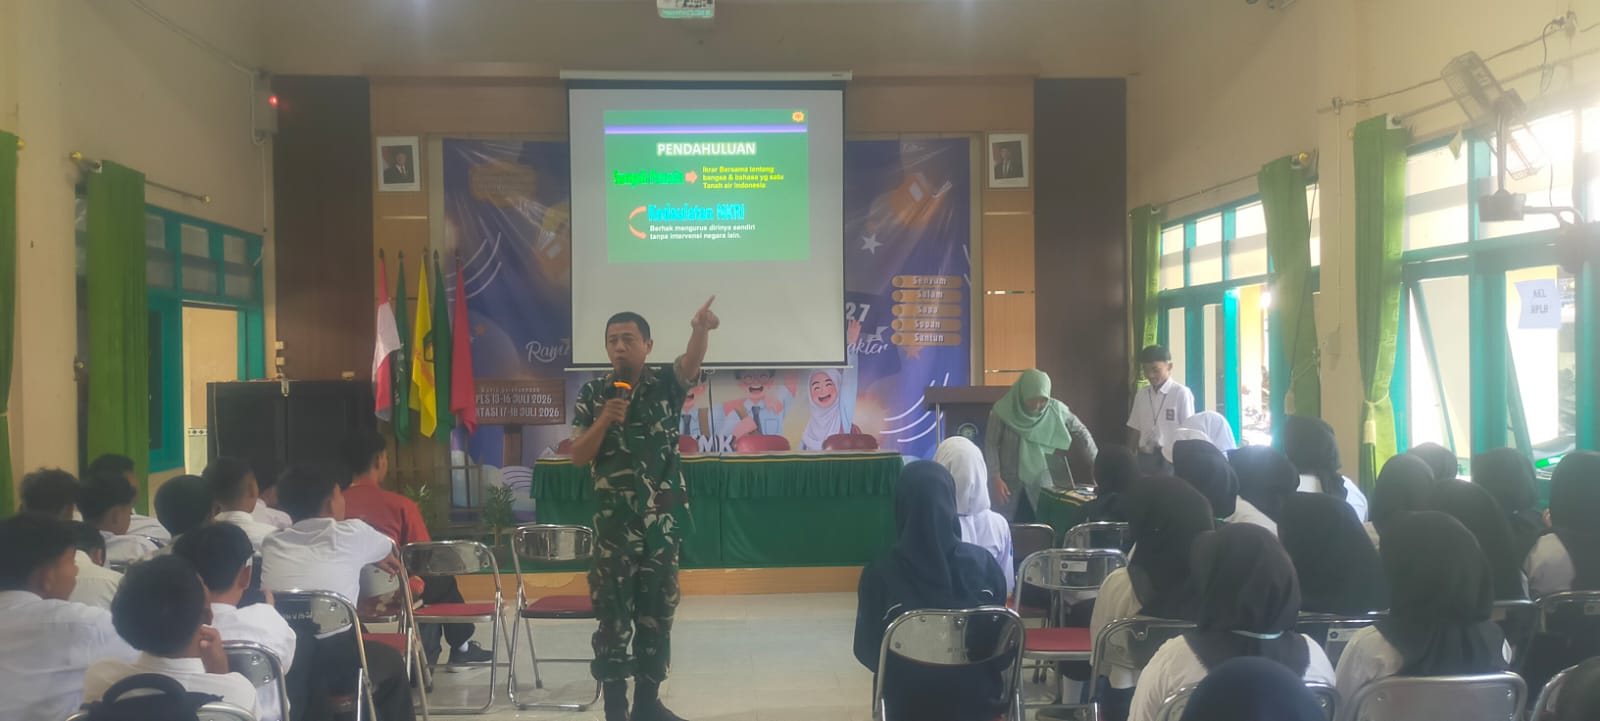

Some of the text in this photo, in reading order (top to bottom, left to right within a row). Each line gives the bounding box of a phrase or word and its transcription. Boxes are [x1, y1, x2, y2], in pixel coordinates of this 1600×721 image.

[657, 142, 756, 156] PENDAHULUAN
[749, 166, 775, 174] tentang
[648, 203, 745, 221] Kedaulatan NKRI
[675, 225, 708, 233] mengurus
[709, 224, 732, 233] dirinya
[733, 223, 756, 231] sendiri
[727, 231, 742, 239] lain.
[912, 275, 947, 285] Senyum
[919, 289, 943, 299] Salam
[846, 302, 870, 322] 27
[919, 305, 939, 314] Sapa
[915, 320, 941, 329] Sopan
[915, 332, 944, 342] Santun
[847, 338, 888, 355] akter
[512, 394, 530, 404] JULI
[519, 407, 537, 417] JULI
[698, 434, 734, 453] MK
